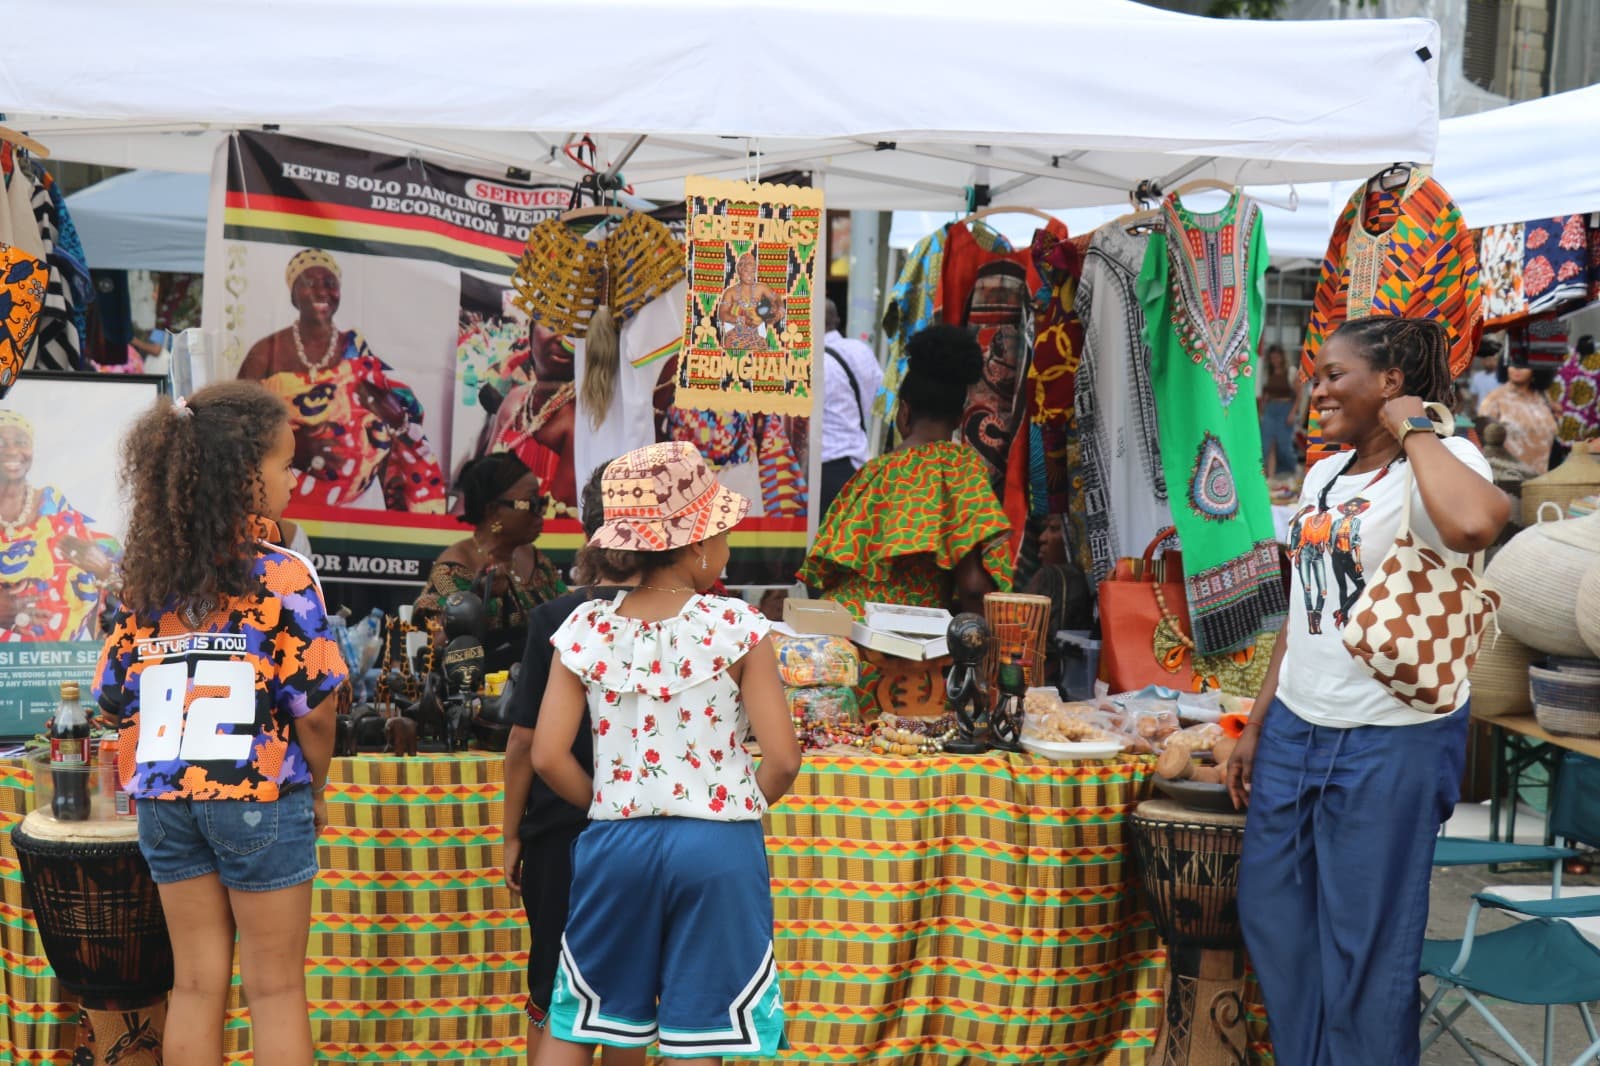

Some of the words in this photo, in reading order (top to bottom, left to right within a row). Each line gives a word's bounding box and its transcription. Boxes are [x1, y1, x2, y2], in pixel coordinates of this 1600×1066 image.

[282, 162, 341, 187] KETE
[345, 174, 401, 196] SOLO
[406, 183, 497, 219] DANCING,
[502, 206, 560, 226] WEDD
[475, 183, 588, 207] SERVICE
[371, 195, 499, 236] DECORATION
[503, 224, 533, 241] FO
[693, 213, 815, 246] GREETINGS
[687, 354, 739, 380] FROM
[738, 357, 811, 381] GHANA
[347, 556, 419, 575] MORE
[19, 651, 72, 665] EVENT
[137, 640, 190, 656] FUTURE
[193, 636, 209, 650] IS
[136, 660, 256, 764] 82
